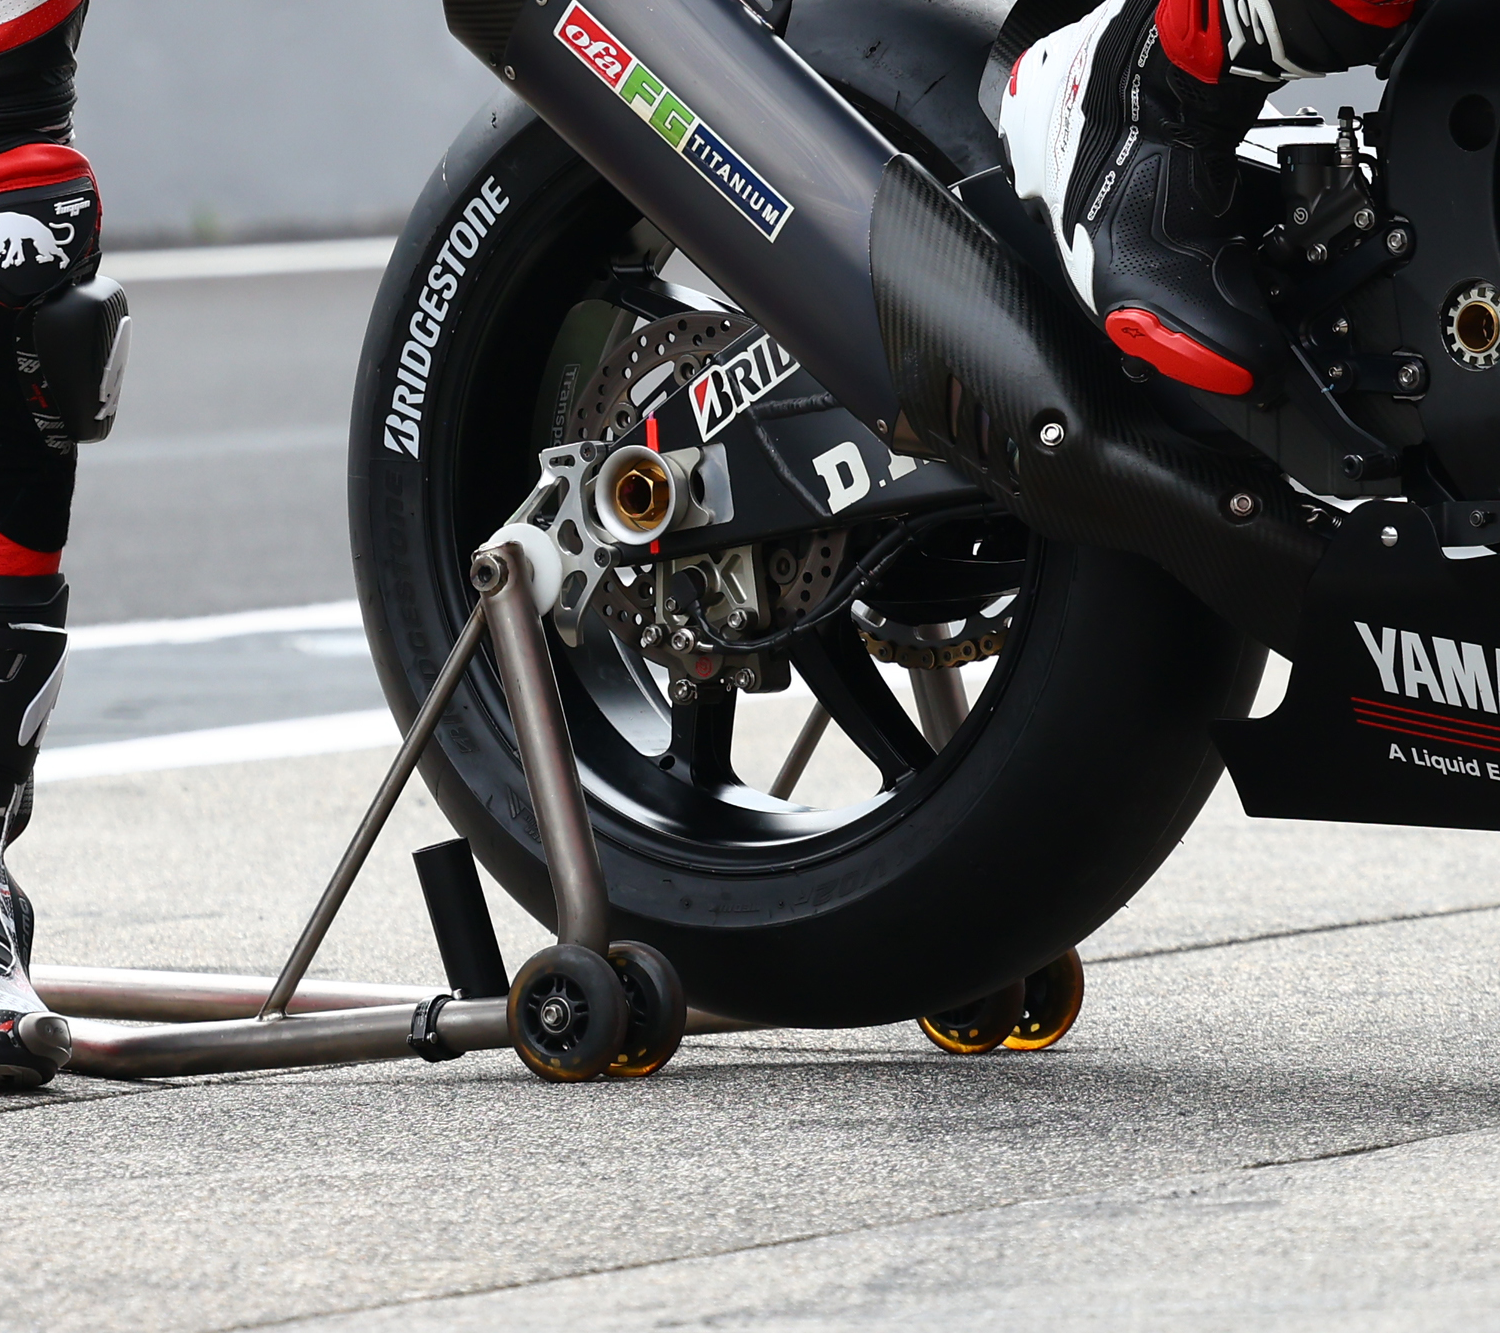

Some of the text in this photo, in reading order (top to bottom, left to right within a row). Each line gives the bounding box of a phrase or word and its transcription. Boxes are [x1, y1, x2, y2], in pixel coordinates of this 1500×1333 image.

[563, 21, 625, 80] ofa
[619, 64, 694, 147] FG
[689, 133, 782, 229] TITANIUM
[383, 175, 511, 460] BRIDGESTONE
[1388, 742, 1407, 763] A
[1413, 747, 1481, 781] Liquid
